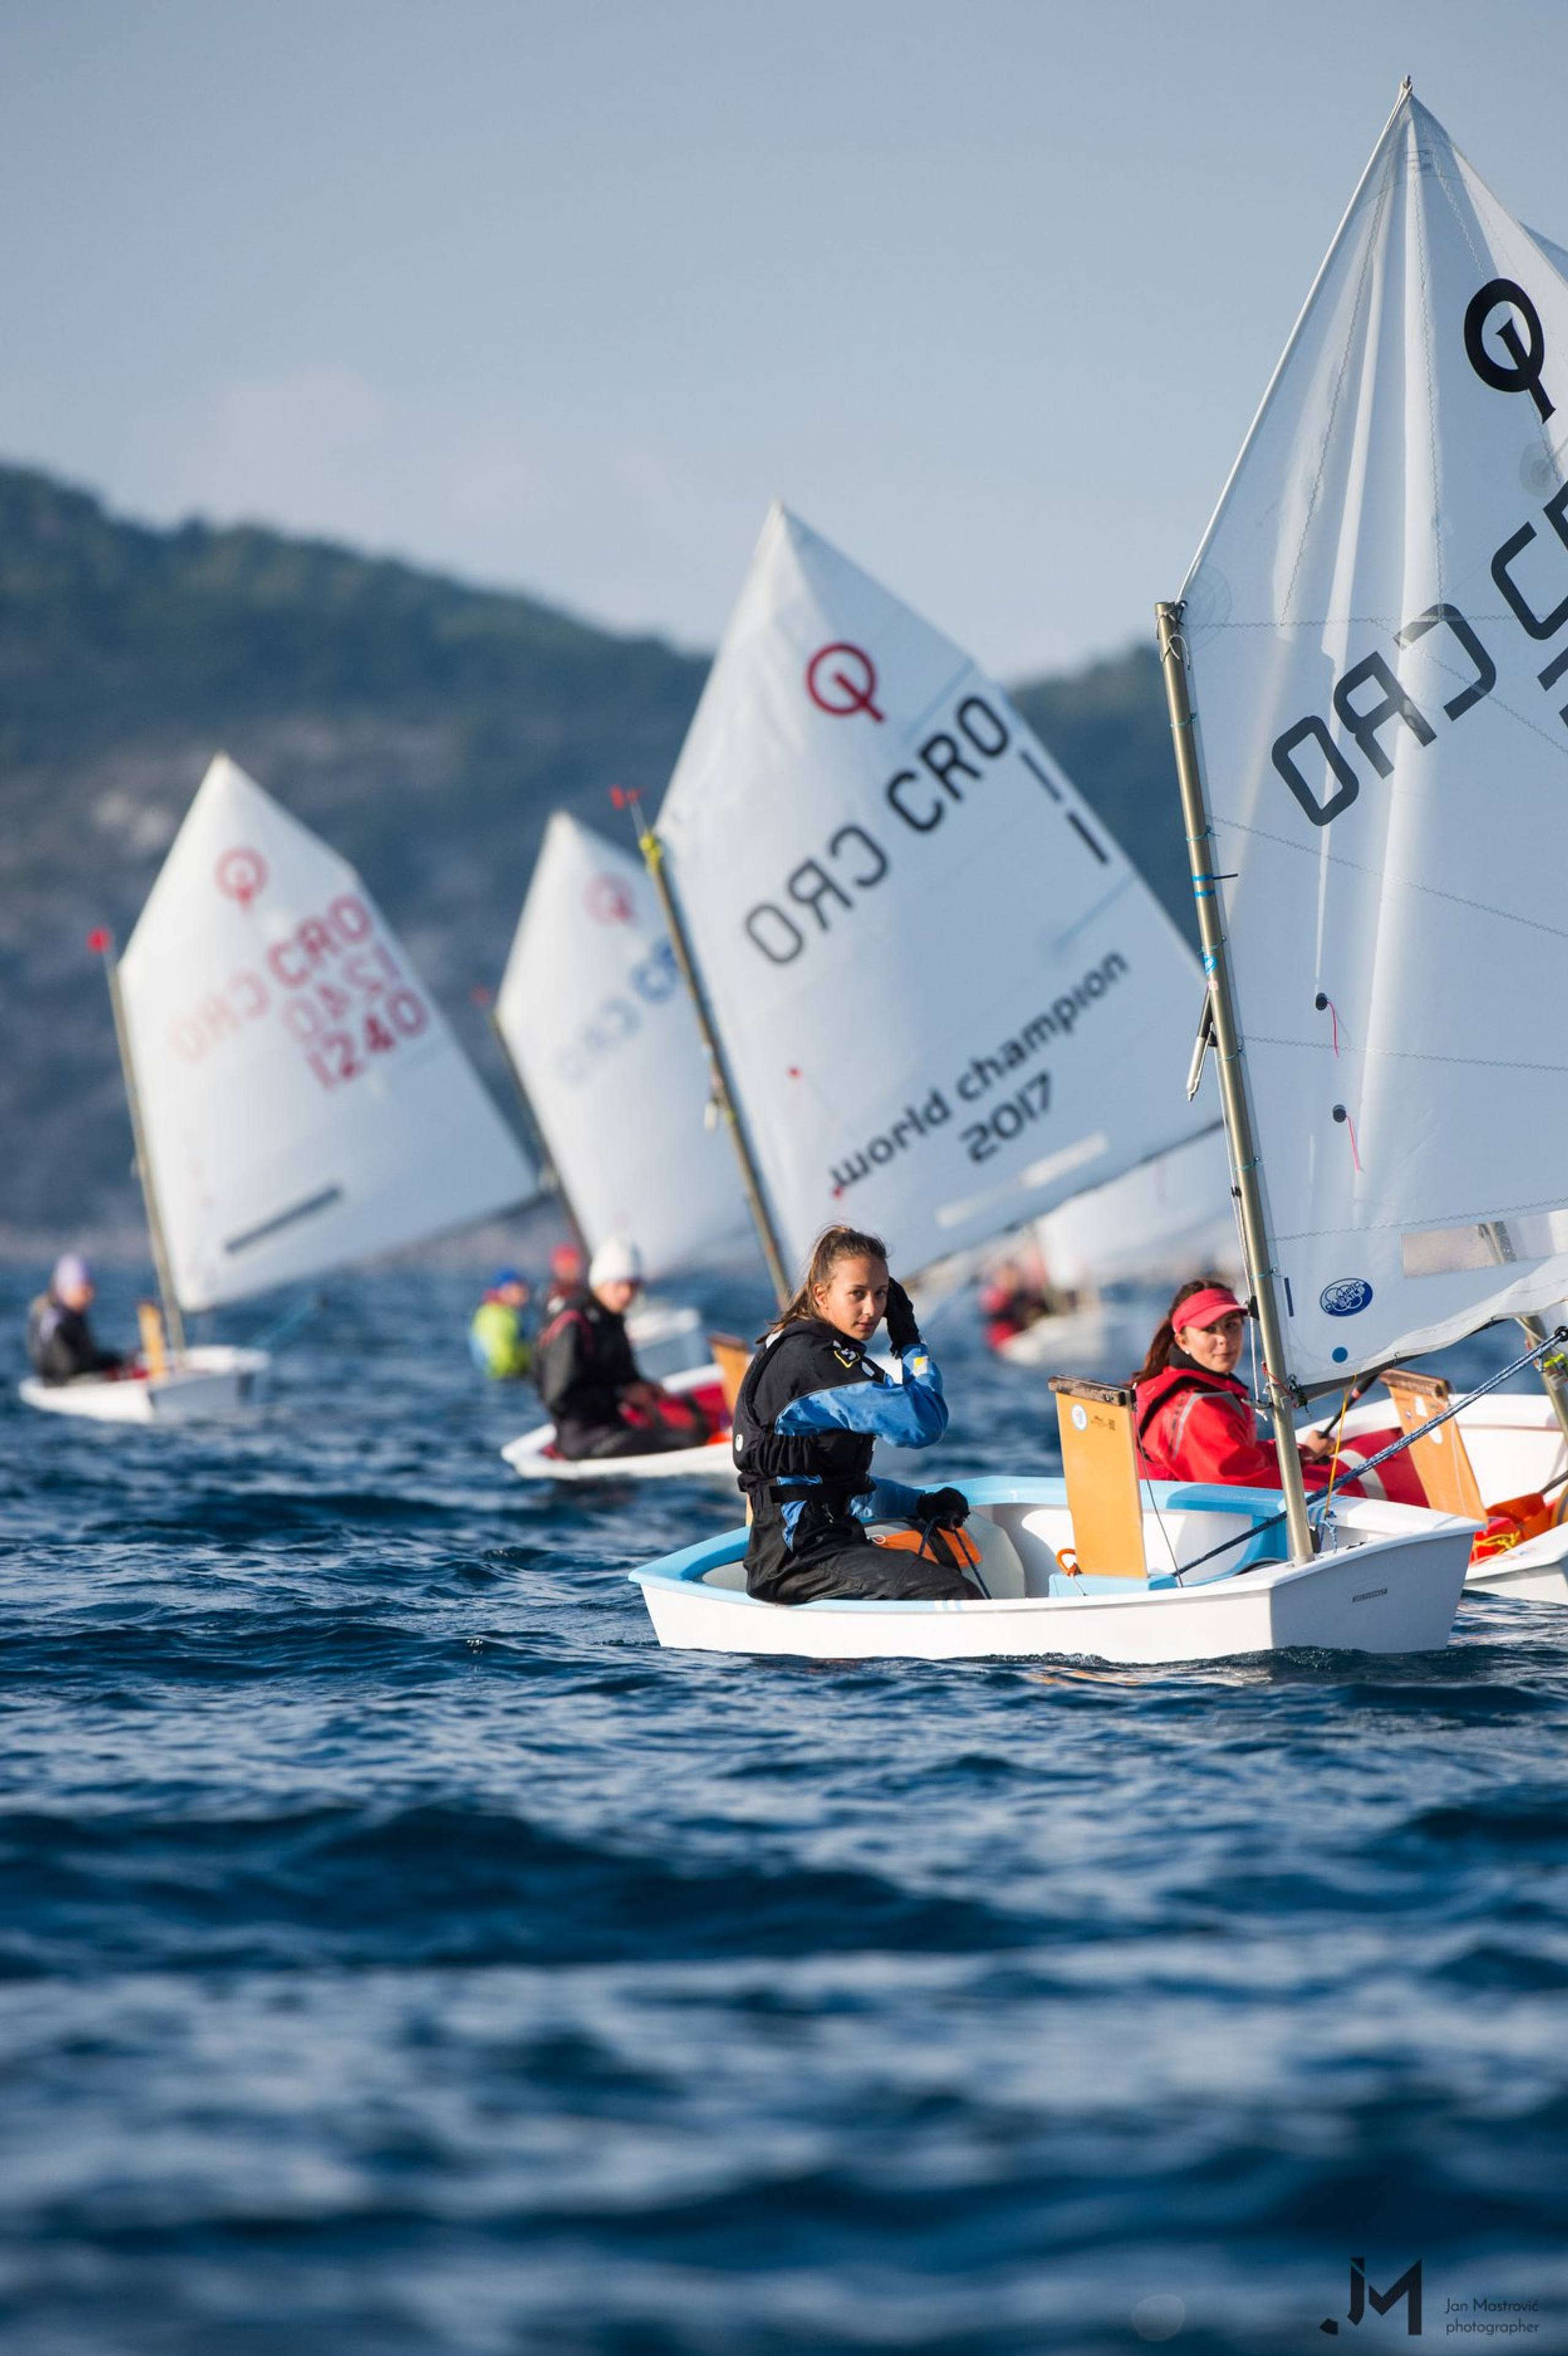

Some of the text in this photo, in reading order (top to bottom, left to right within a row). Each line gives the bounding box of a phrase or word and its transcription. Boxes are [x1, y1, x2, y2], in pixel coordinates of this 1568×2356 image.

[886, 694, 1010, 833] CRO
[267, 894, 372, 987] CRO
[306, 986, 429, 1089] 1240
[829, 950, 1129, 1187] world champion
[959, 1070, 1052, 1165] 2017
